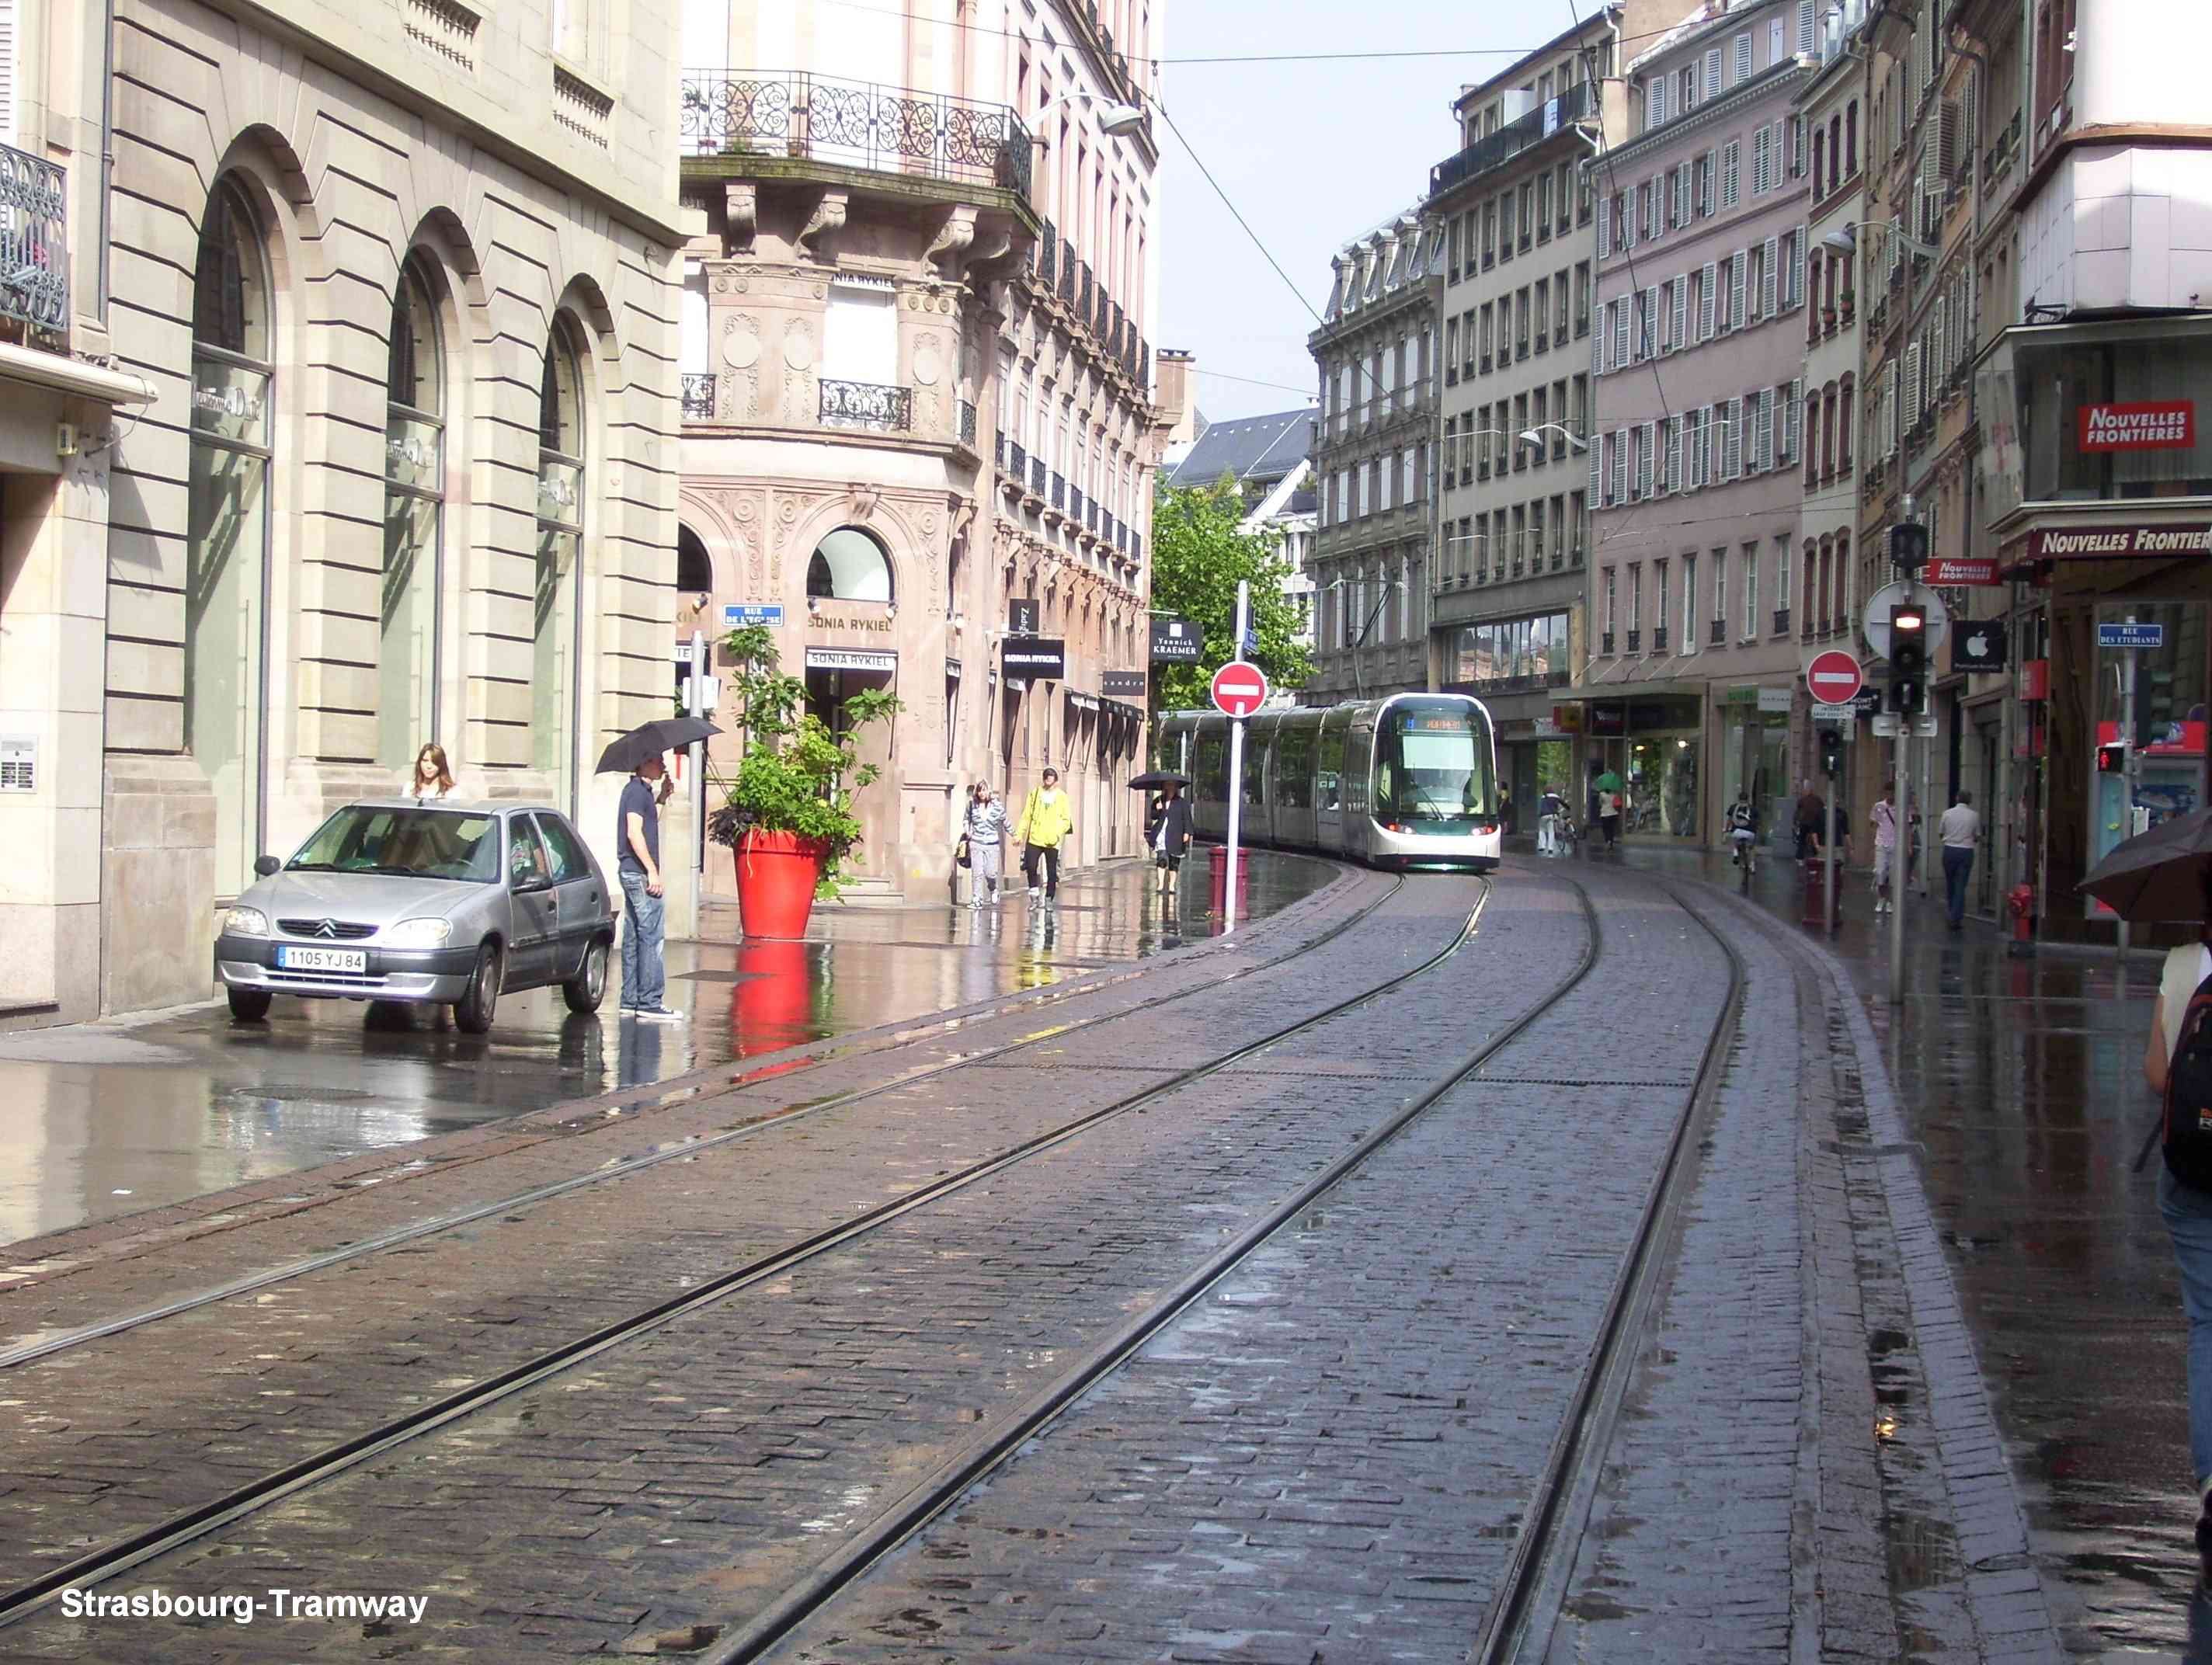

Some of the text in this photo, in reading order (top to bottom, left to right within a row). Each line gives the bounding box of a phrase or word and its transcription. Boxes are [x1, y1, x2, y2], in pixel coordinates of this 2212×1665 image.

[832, 273, 855, 283] NIA
[2089, 408, 2186, 429] NOUVELLES
[2088, 426, 2184, 443] FRONTIERES
[2042, 529, 2210, 554] NOUVELLES FRONTIER
[808, 617, 891, 632] SONIA RYKIEL
[1153, 645, 1196, 655] KRAEMER
[812, 653, 889, 666] SONIA RYKIEL
[1031, 655, 1061, 663] RYKIEL
[291, 951, 361, 968] 1105 YJ 84
